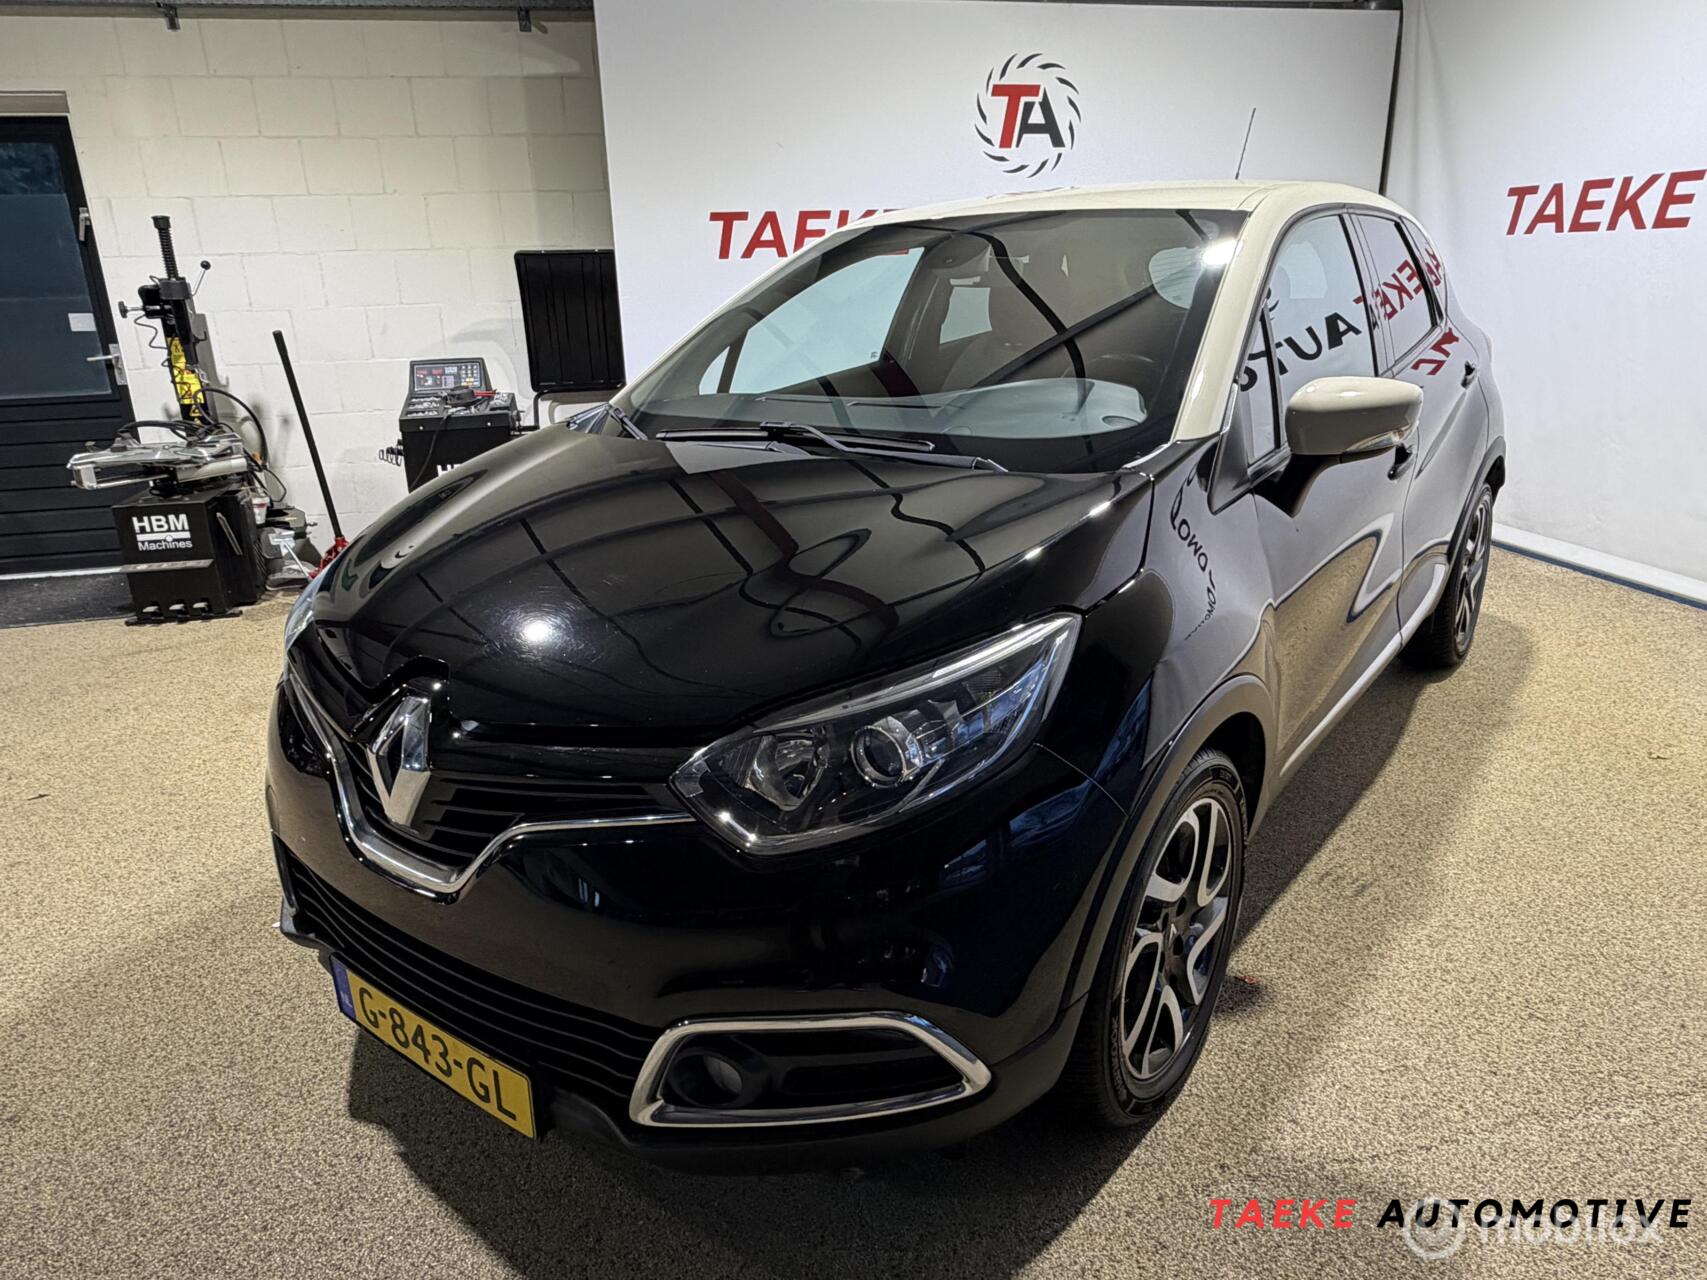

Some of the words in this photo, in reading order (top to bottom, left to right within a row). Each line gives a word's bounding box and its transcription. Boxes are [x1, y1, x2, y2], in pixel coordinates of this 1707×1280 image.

[990, 83, 1066, 149] TA
[1506, 168, 1707, 236] TAEKE
[709, 209, 906, 260] TAE
[132, 513, 190, 533] HBM
[137, 540, 193, 552] Machines
[358, 986, 518, 1122] G-843-GL
